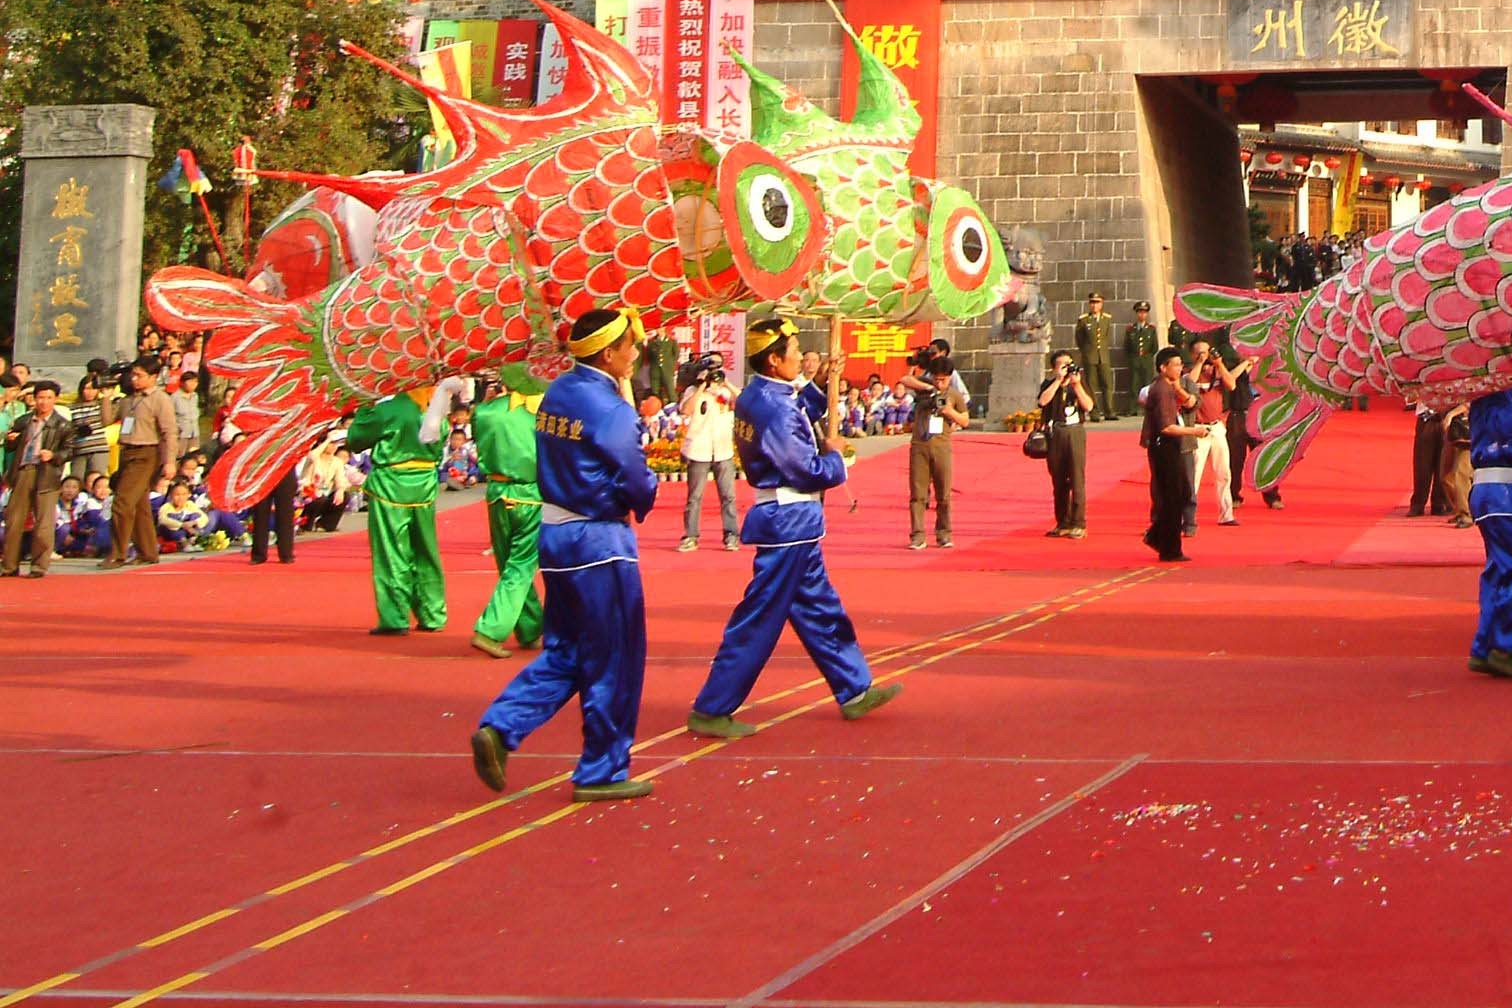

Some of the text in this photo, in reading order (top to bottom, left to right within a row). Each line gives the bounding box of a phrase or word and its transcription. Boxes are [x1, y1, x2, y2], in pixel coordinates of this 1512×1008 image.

[604, 15, 628, 37] 打
[858, 25, 922, 70] 做
[548, 41, 569, 98] 加快
[848, 321, 916, 364] 章
